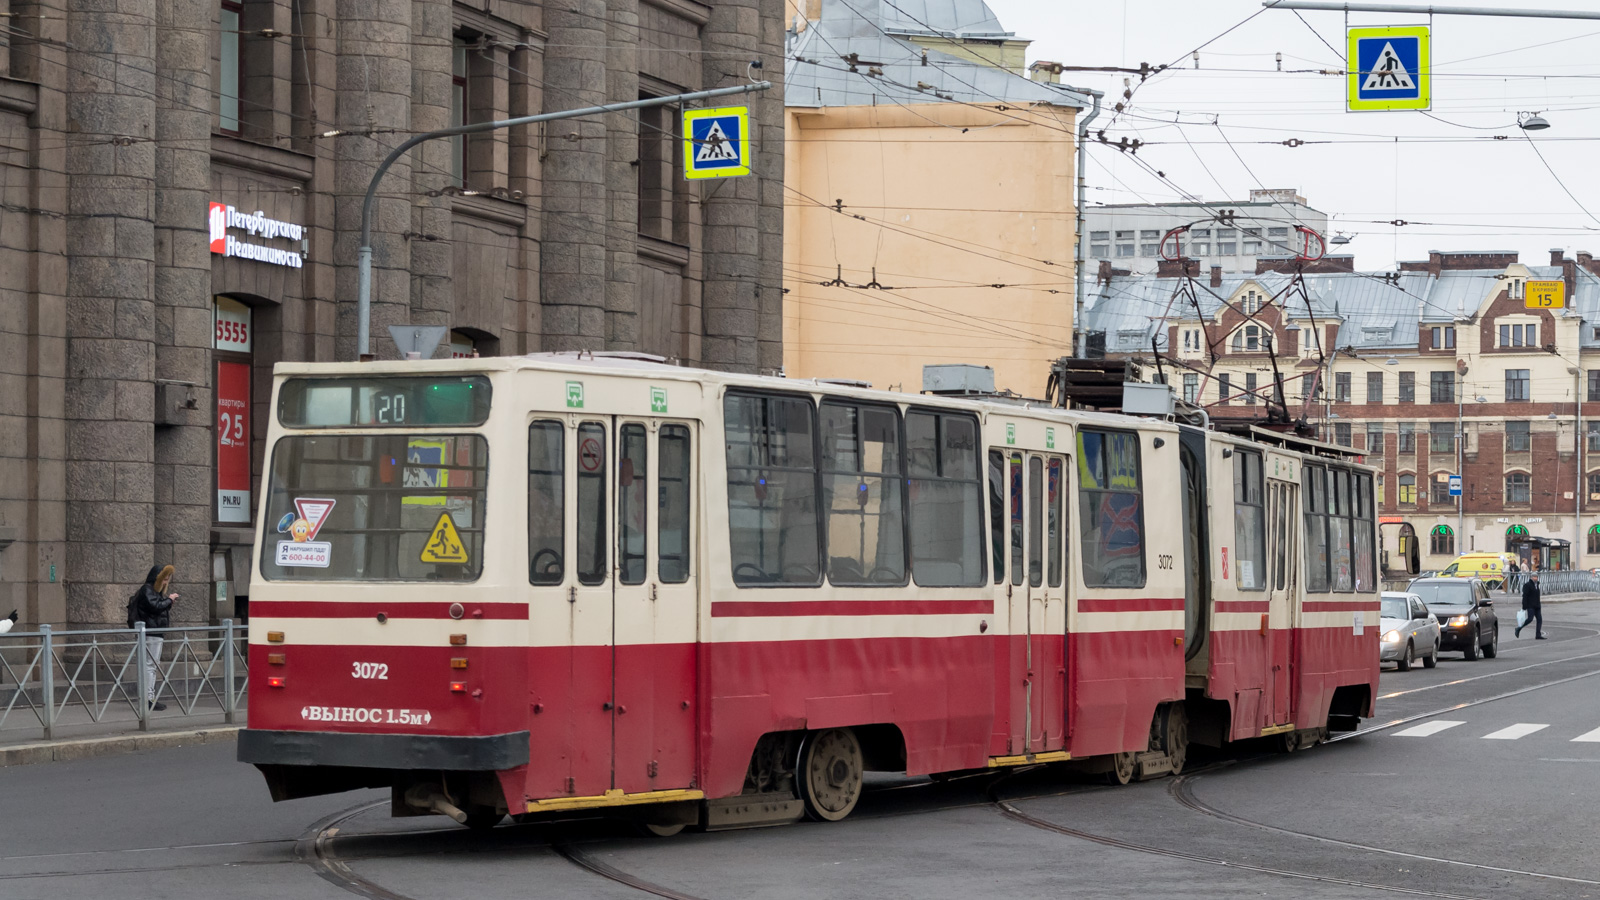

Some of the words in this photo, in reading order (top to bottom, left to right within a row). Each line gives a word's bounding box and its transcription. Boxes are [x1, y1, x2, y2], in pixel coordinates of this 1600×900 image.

[226, 205, 302, 241] Петербургская
[225, 235, 303, 268] Недвижимость
[1537, 294, 1552, 306] 15
[218, 398, 246, 409] квартиры
[379, 394, 405, 424] 20
[222, 495, 241, 506] PN.RU
[282, 545, 289, 553] Я
[288, 553, 326, 562] 600-44-00
[1158, 554, 1173, 570] 3072
[351, 661, 388, 680] 3072
[308, 705, 383, 723] ВЫНОС
[386, 708, 422, 725] 1.5м
